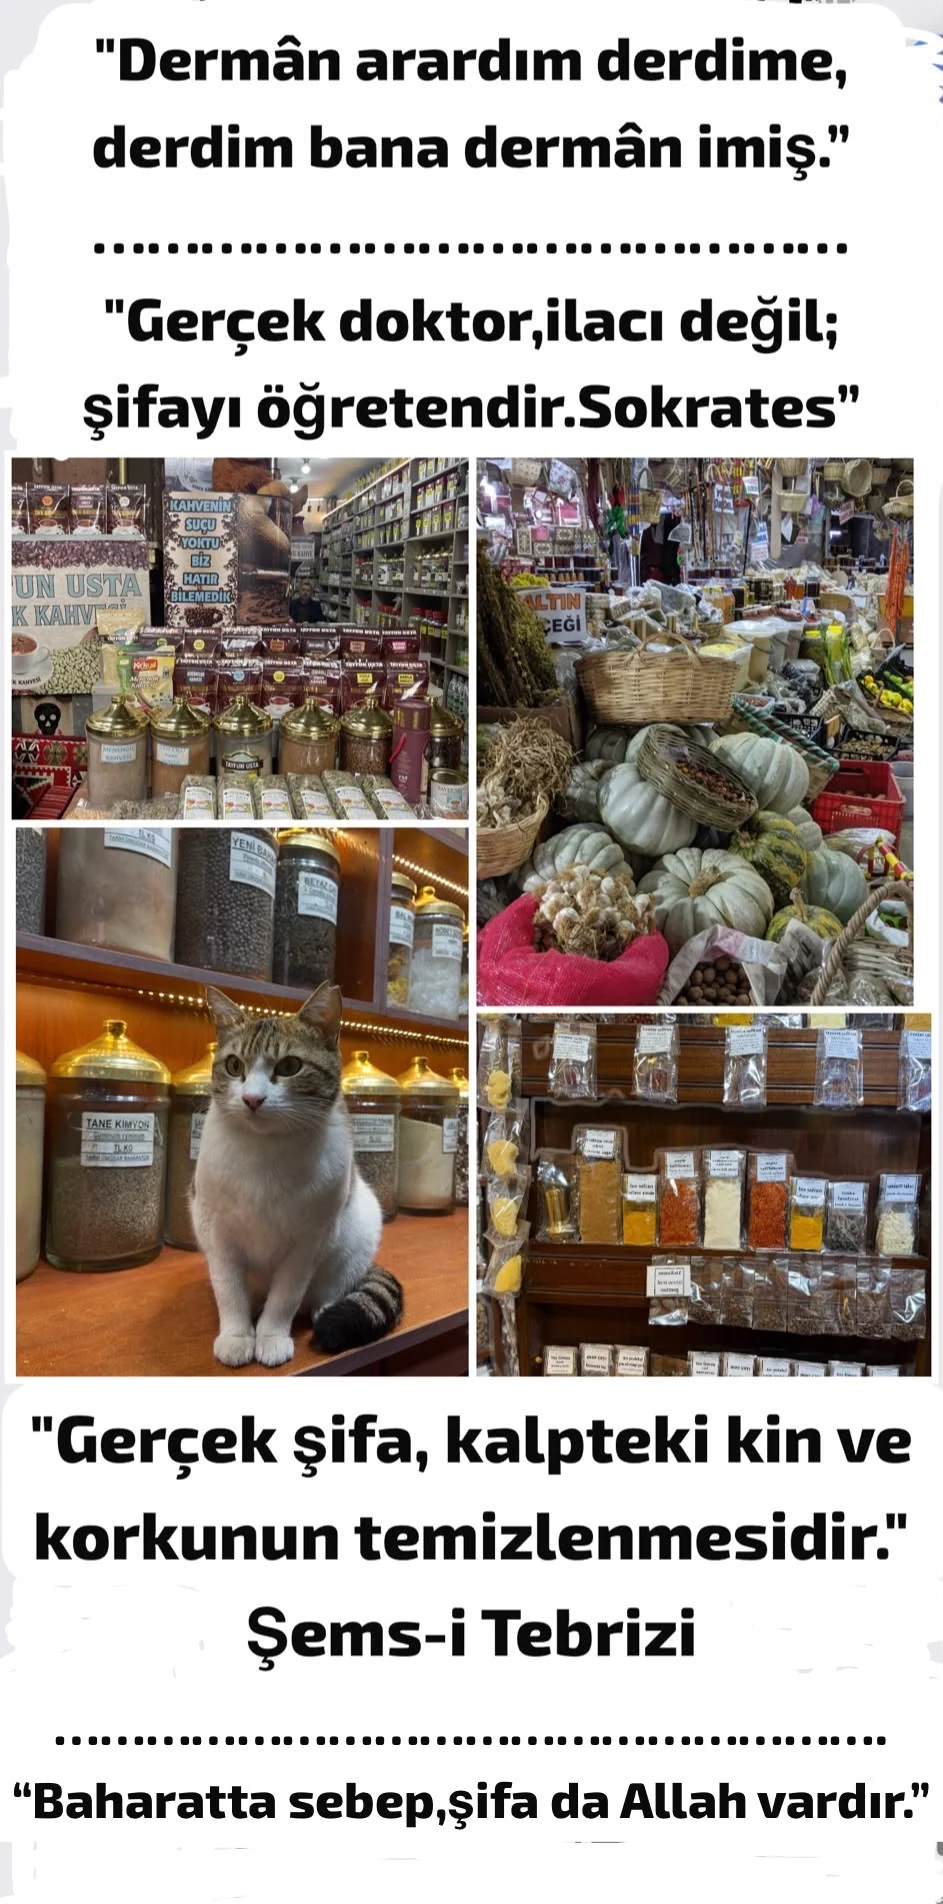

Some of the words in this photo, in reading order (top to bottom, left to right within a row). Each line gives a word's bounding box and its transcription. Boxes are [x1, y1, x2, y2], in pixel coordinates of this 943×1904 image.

[170, 496, 232, 513] KAHVENİN
[184, 518, 216, 535] SUÇU
[181, 536, 221, 550] YOKTU
[191, 551, 211, 567] BİZ
[12, 574, 55, 598] UN
[66, 573, 142, 598] USTA
[183, 573, 219, 585] HATIR
[170, 587, 232, 603] BİLEMEDİK
[523, 592, 581, 611] ALTIN
[35, 599, 127, 627] KAHV
[543, 614, 581, 636] ÇEĞİ
[231, 836, 256, 852] YENİ
[87, 1118, 113, 1129] TANE
